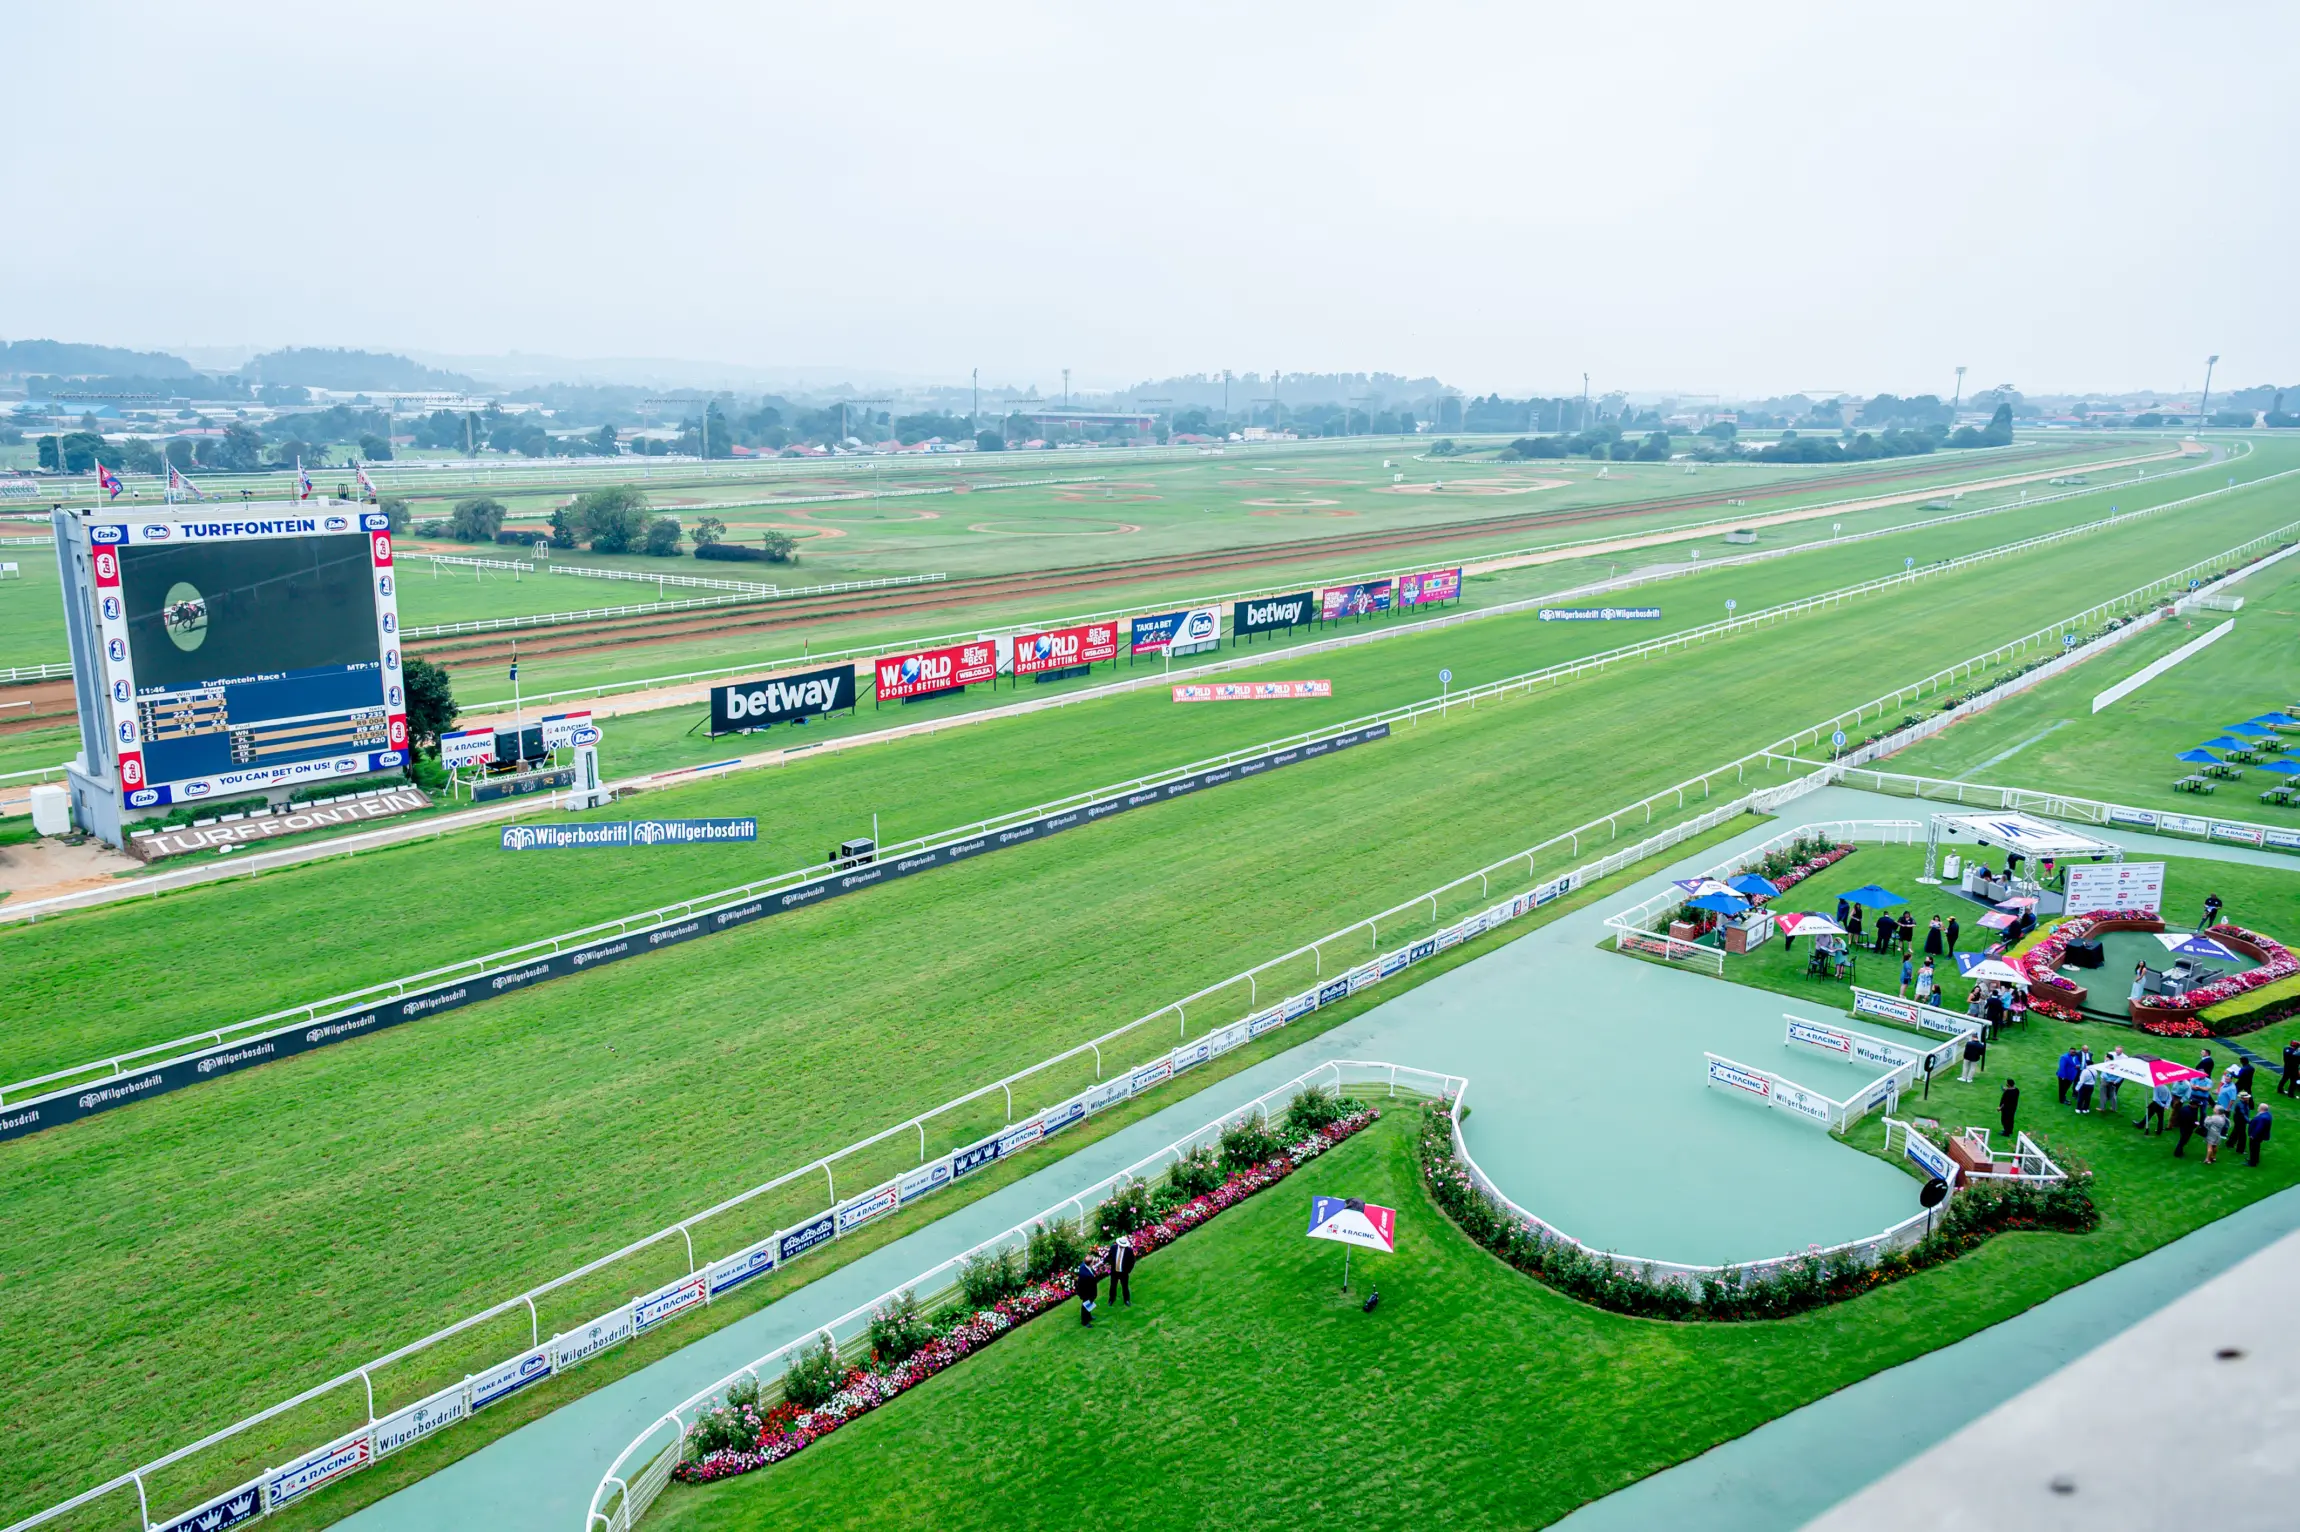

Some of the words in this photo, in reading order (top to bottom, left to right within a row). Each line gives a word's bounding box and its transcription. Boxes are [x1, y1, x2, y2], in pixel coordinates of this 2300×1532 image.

[97, 530, 118, 539] tab
[181, 519, 316, 538] TURFFONTEIN
[102, 557, 111, 574] tab
[1247, 600, 1303, 625] betway
[1555, 610, 1599, 620] Wilgerbosdrift
[1615, 608, 1660, 618] Wilgerbosdrift
[1089, 627, 1103, 638] BET
[1136, 622, 1154, 632] TAKE
[1154, 622, 1160, 630] A
[1160, 619, 1172, 629] BET
[1193, 620, 1212, 633] tab
[1093, 635, 1110, 646] BEST
[964, 646, 980, 658] BET
[968, 655, 988, 666] BEST
[346, 663, 368, 672] MTP:
[369, 661, 379, 669] 19
[1017, 660, 1046, 672] SPORTS
[1048, 655, 1078, 668] BETTING
[201, 675, 256, 688] Turffontein
[257, 673, 280, 682] Race
[880, 685, 913, 698] SPORTS
[917, 677, 951, 692] BETTING
[139, 685, 166, 695] 11:46
[206, 692, 222, 701] 0.9
[726, 676, 840, 720] betway
[173, 709, 195, 718] 22.5
[180, 722, 196, 730] 5.6
[211, 718, 227, 726] 2.6
[353, 739, 369, 747] R18
[460, 740, 492, 751] RACING
[219, 776, 244, 786] YOU
[246, 772, 269, 782] CAN
[272, 767, 293, 778] BET
[295, 764, 312, 774] ON
[314, 762, 331, 771] US!
[135, 793, 154, 803] tab
[144, 792, 423, 856] TURFFONTEIN
[664, 821, 755, 841] Wilgerbosdrift
[535, 825, 628, 847] Wilgerbosdrift
[728, 904, 762, 919] Wilgerbosdrift
[662, 922, 699, 940] Wilgerbosdrift
[587, 942, 628, 960] Wilgerbosdrift
[506, 965, 549, 985] Wilgerbosdrift
[419, 989, 467, 1009] Wilgerbosdrift
[1880, 1004, 1908, 1017] RACING
[323, 1015, 376, 1037] Wilgerbosdrift
[1812, 1033, 1841, 1047] RACING
[215, 1043, 275, 1067] Wilgerbosdrift
[100, 1075, 163, 1101] Wilgerbosdrift
[1732, 1074, 1761, 1089] RACING
[1776, 1092, 1826, 1119] Wilgerbosdrift
[1016, 1129, 1039, 1144] RACING
[862, 1198, 889, 1216] RACING
[1348, 1229, 1375, 1239] RACING
[786, 1249, 794, 1257] SA
[795, 1240, 813, 1252] TRIPLE
[814, 1231, 831, 1243] TIARA
[716, 1270, 731, 1281] TAKE
[737, 1263, 748, 1272] BET
[663, 1290, 697, 1311] RACING
[561, 1324, 630, 1364] Wilgerbosdrift
[477, 1381, 496, 1394] TAKE
[503, 1371, 517, 1382] BET
[380, 1404, 462, 1451] Wilgerbosdrift
[299, 1475, 307, 1484] 4
[309, 1452, 356, 1480] RACING
[217, 1511, 251, 1530] CROWN
